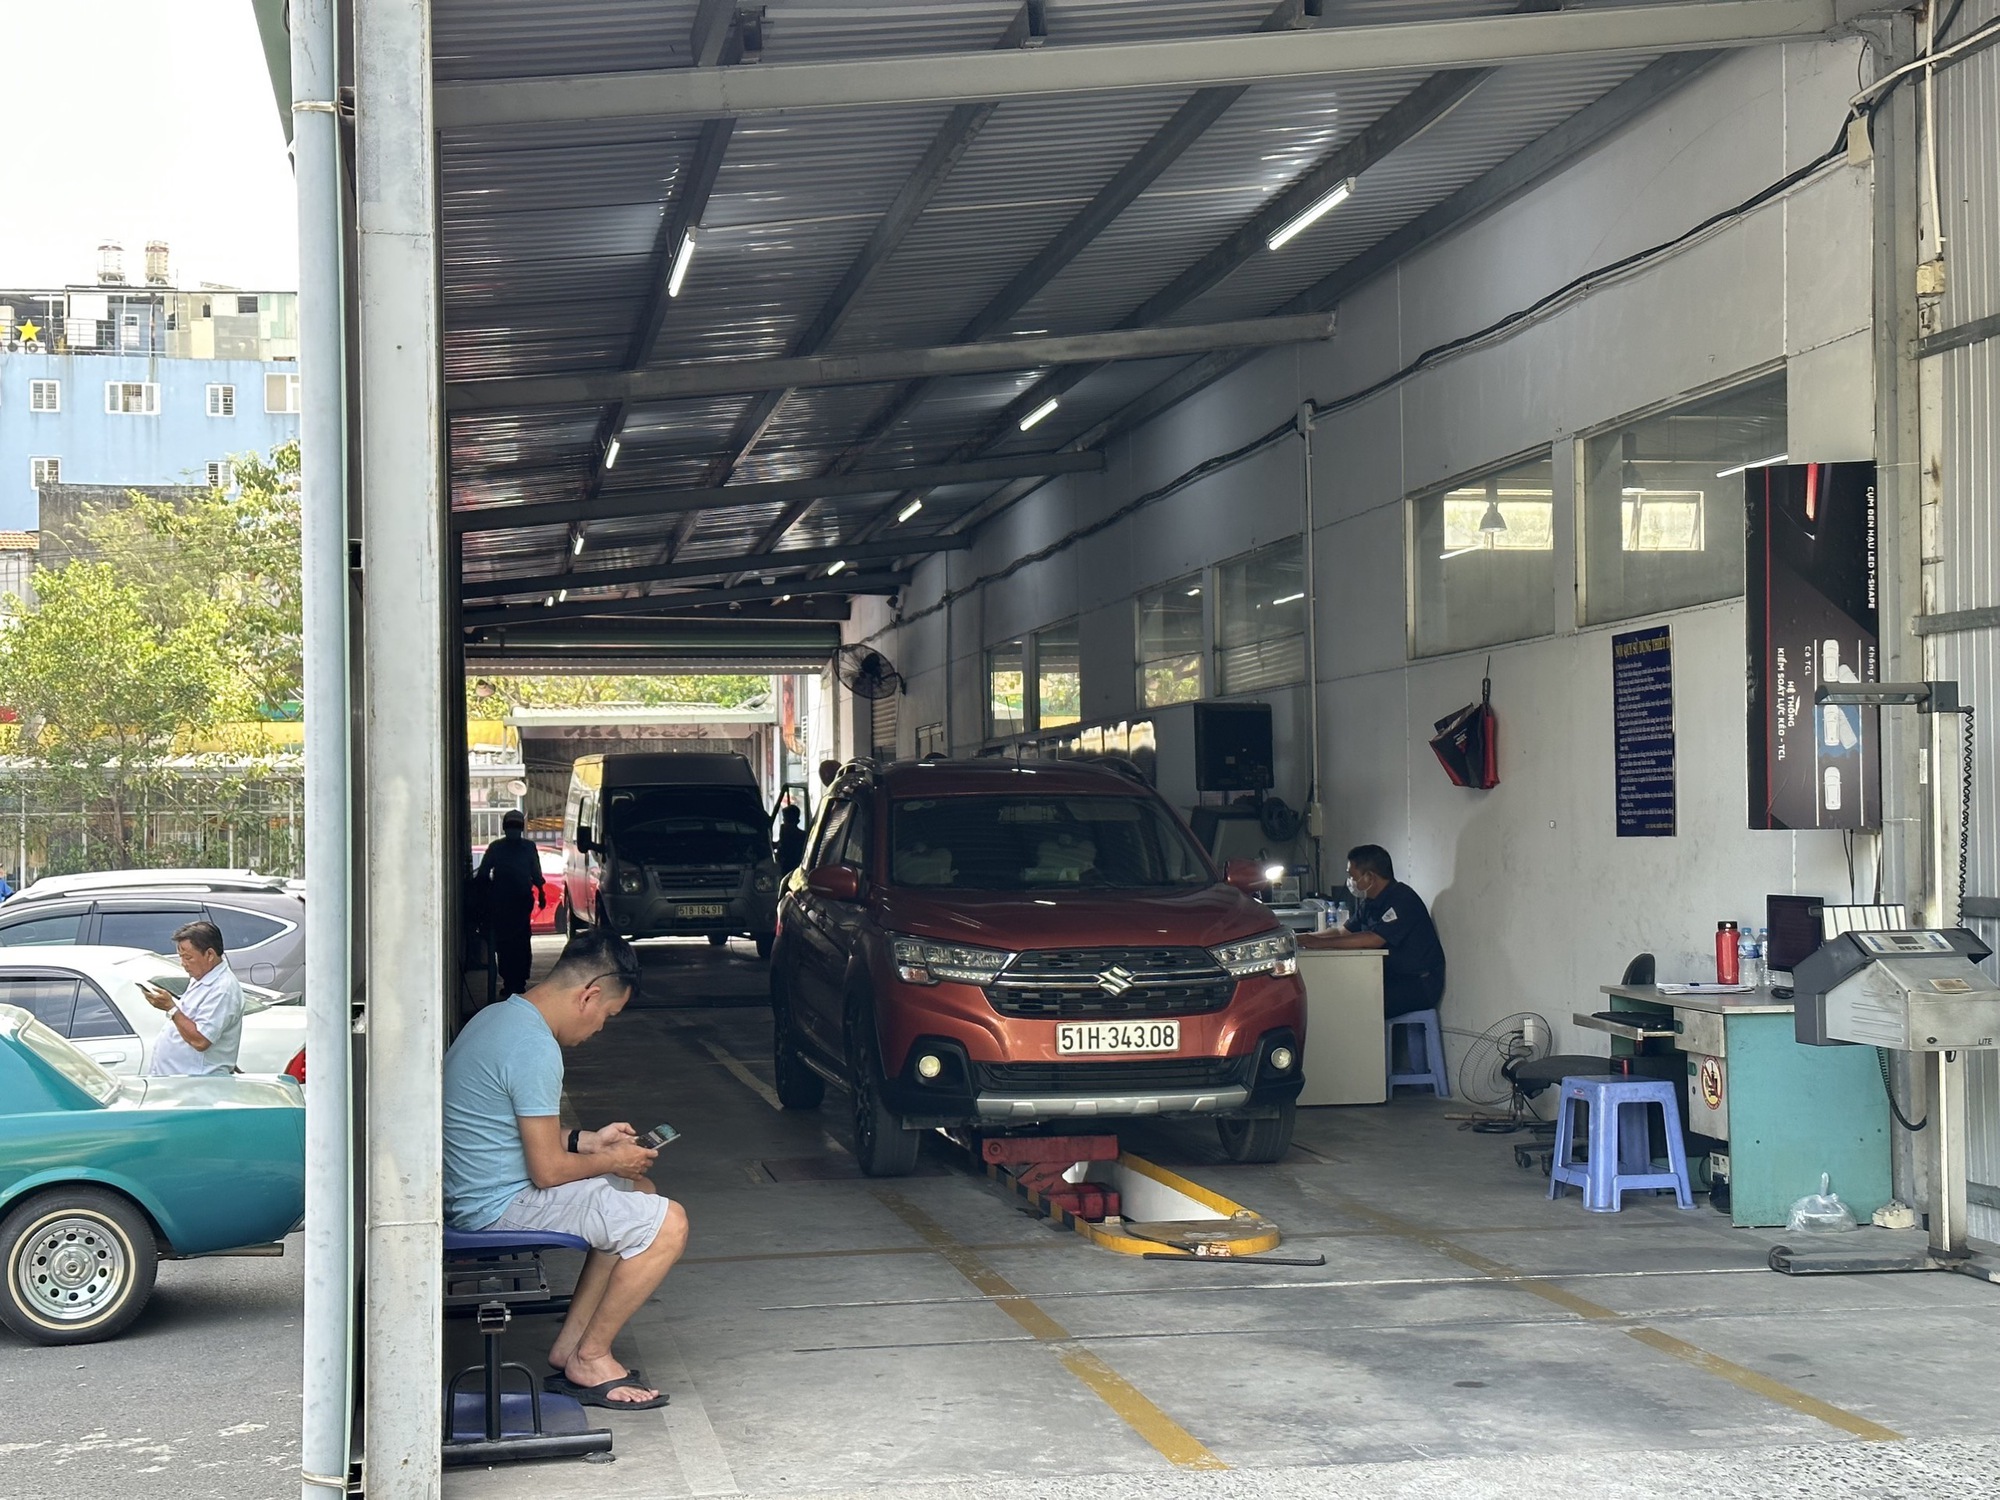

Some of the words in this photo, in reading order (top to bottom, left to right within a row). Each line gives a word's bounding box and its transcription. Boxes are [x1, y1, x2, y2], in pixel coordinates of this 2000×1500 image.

[1867, 551, 1875, 568] LED
[1867, 569, 1875, 609] T-SHAPE
[1867, 646, 1875, 674] Không
[1777, 673, 1786, 697] SOÁT
[1786, 680, 1796, 693] HỆ
[1776, 698, 1786, 715] LỰC
[1777, 717, 1786, 736] KÉO
[1062, 1025, 1175, 1050] 51H-343.08
[1978, 1037, 1993, 1046] LITE
